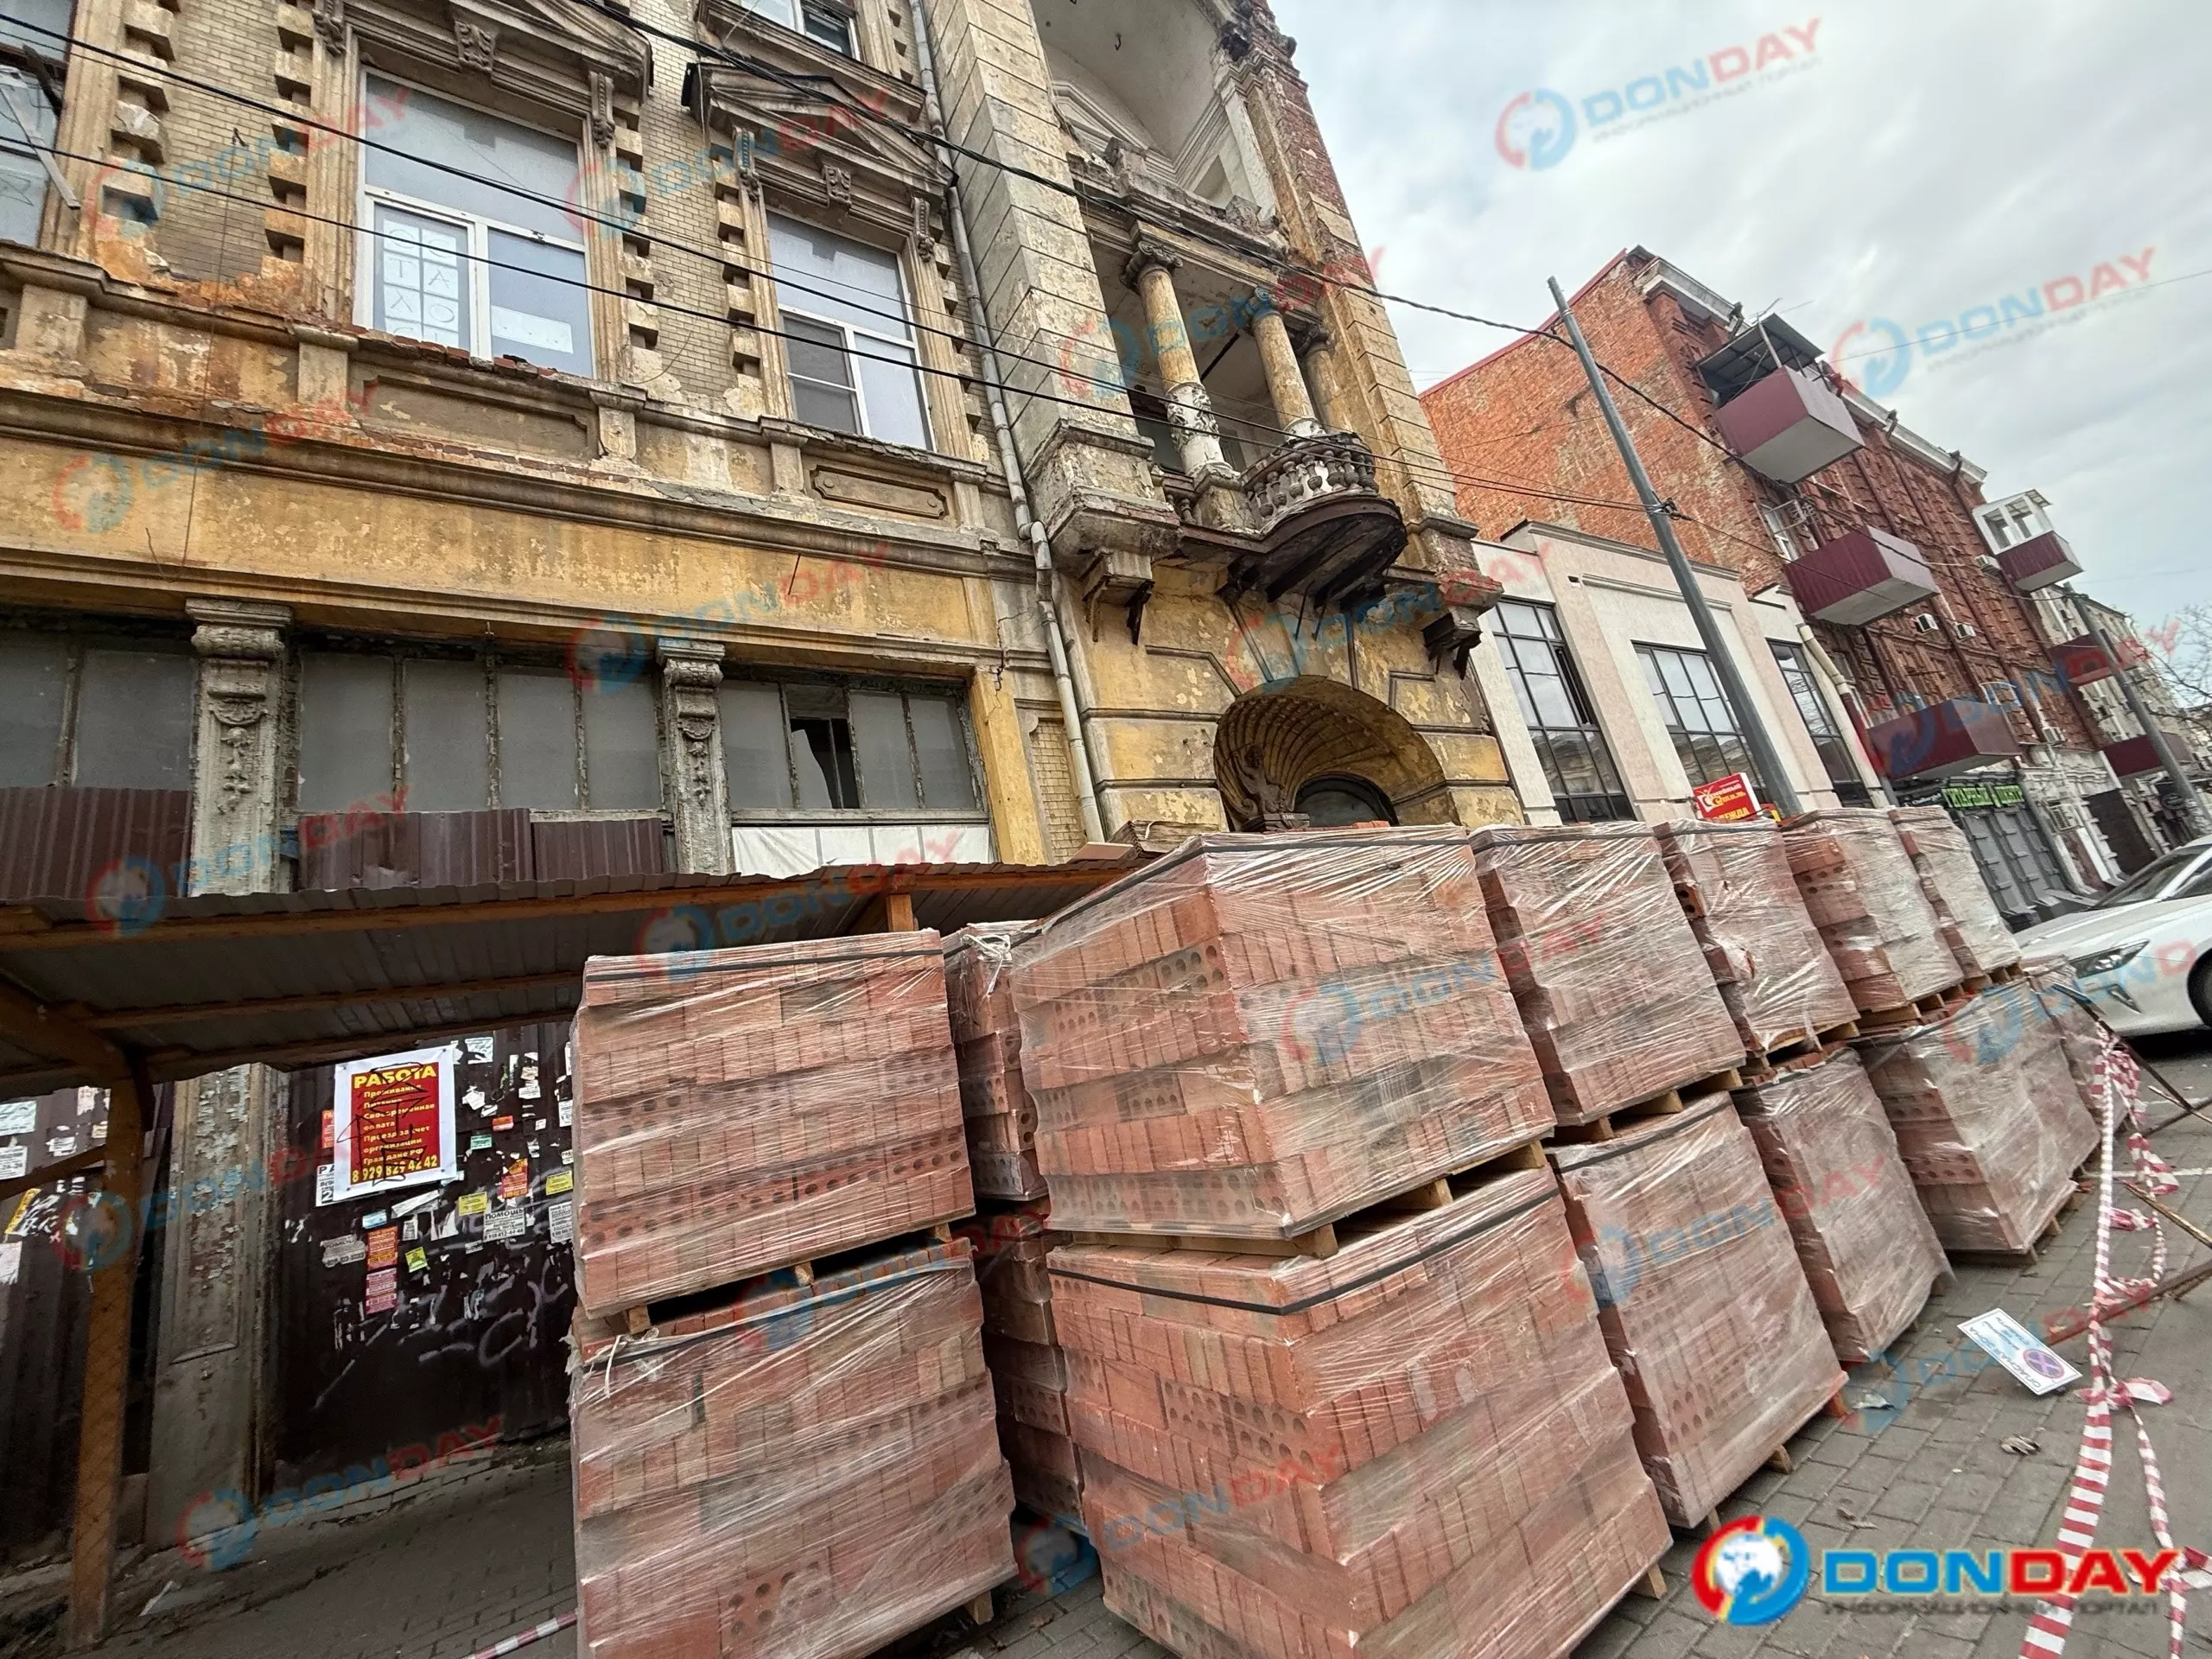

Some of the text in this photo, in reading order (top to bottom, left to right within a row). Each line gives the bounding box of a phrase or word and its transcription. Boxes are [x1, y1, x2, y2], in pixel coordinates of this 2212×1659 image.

[354, 1065, 437, 1089] РАБОТА
[410, 1147, 424, 1156] РФ
[352, 1170, 359, 1183] 8
[363, 1166, 384, 1181] 929
[424, 1154, 438, 1167] 42
